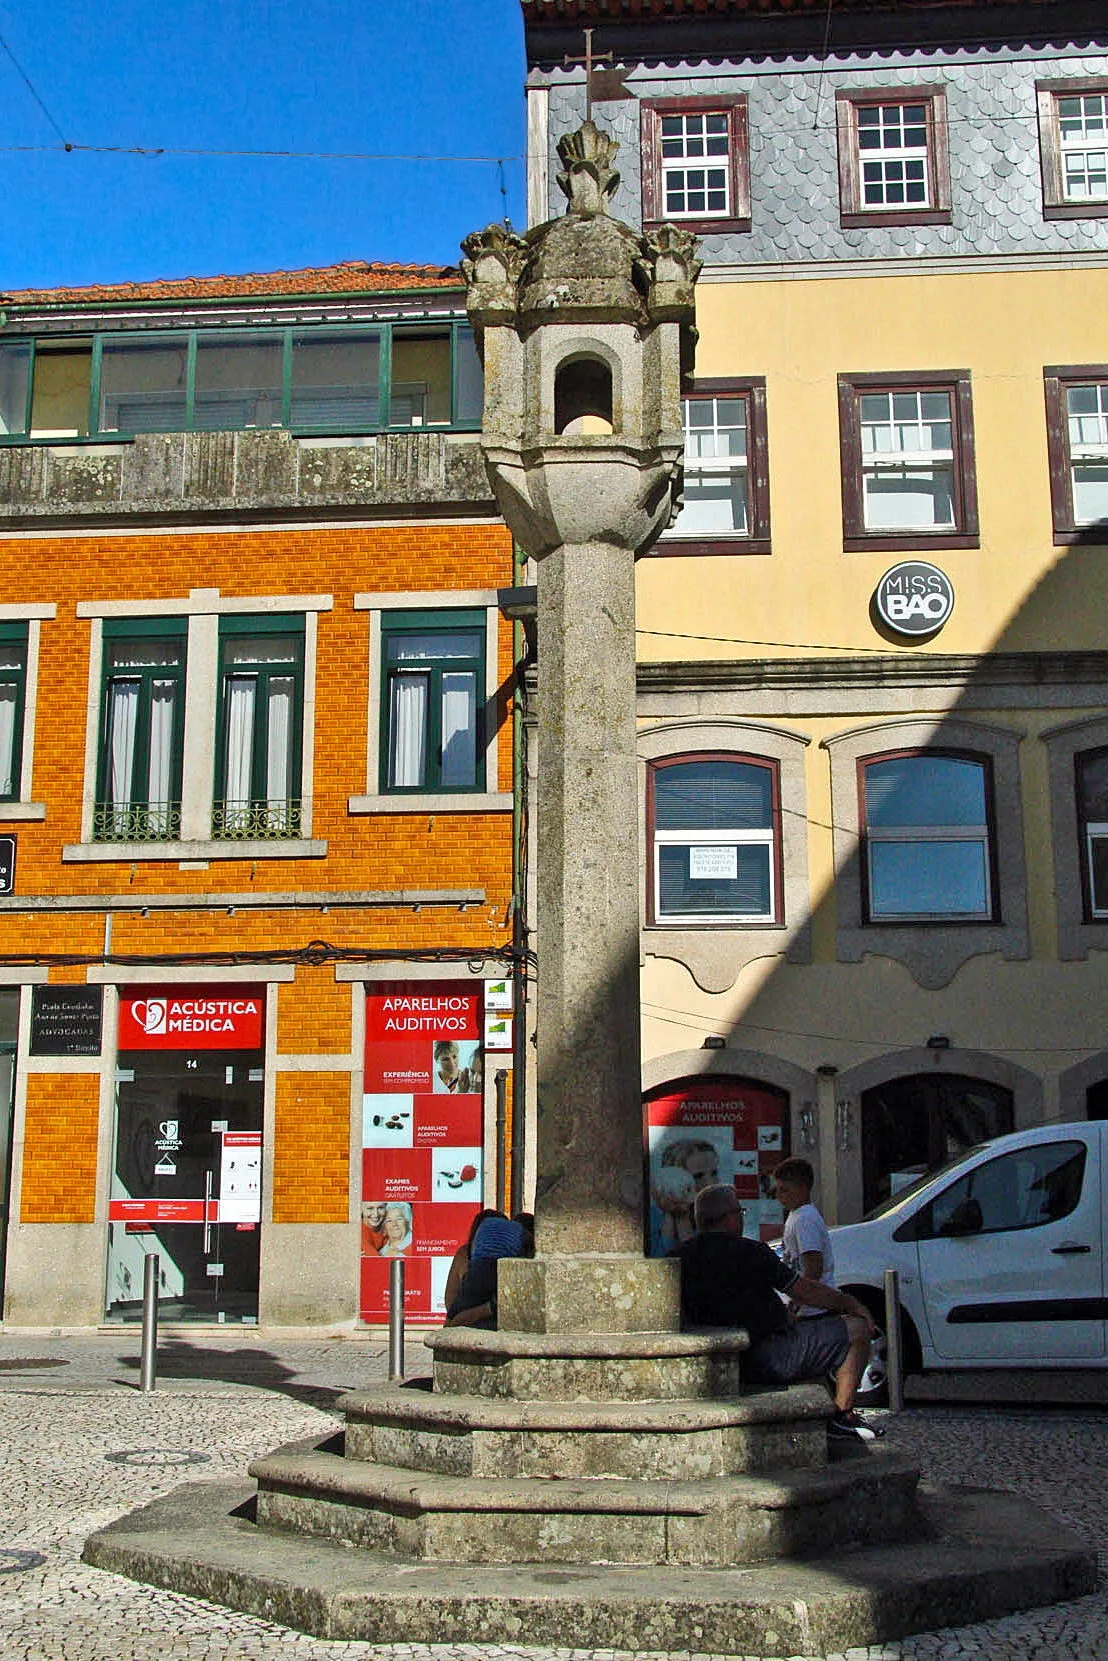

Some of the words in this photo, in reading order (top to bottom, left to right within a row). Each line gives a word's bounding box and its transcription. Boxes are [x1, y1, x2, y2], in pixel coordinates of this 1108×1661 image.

[886, 593, 948, 620] BAO
[169, 999, 257, 1014] ACÚSTICA
[382, 997, 470, 1011] APARELHOS
[168, 1016, 235, 1032] MÉDICA
[384, 1017, 467, 1031] AUDITIVOS
[186, 1060, 197, 1069] 14
[383, 1070, 429, 1078] EXPERIÊNCIA
[680, 1101, 746, 1110] APARELHOS
[682, 1112, 744, 1122] AUDITIVOS
